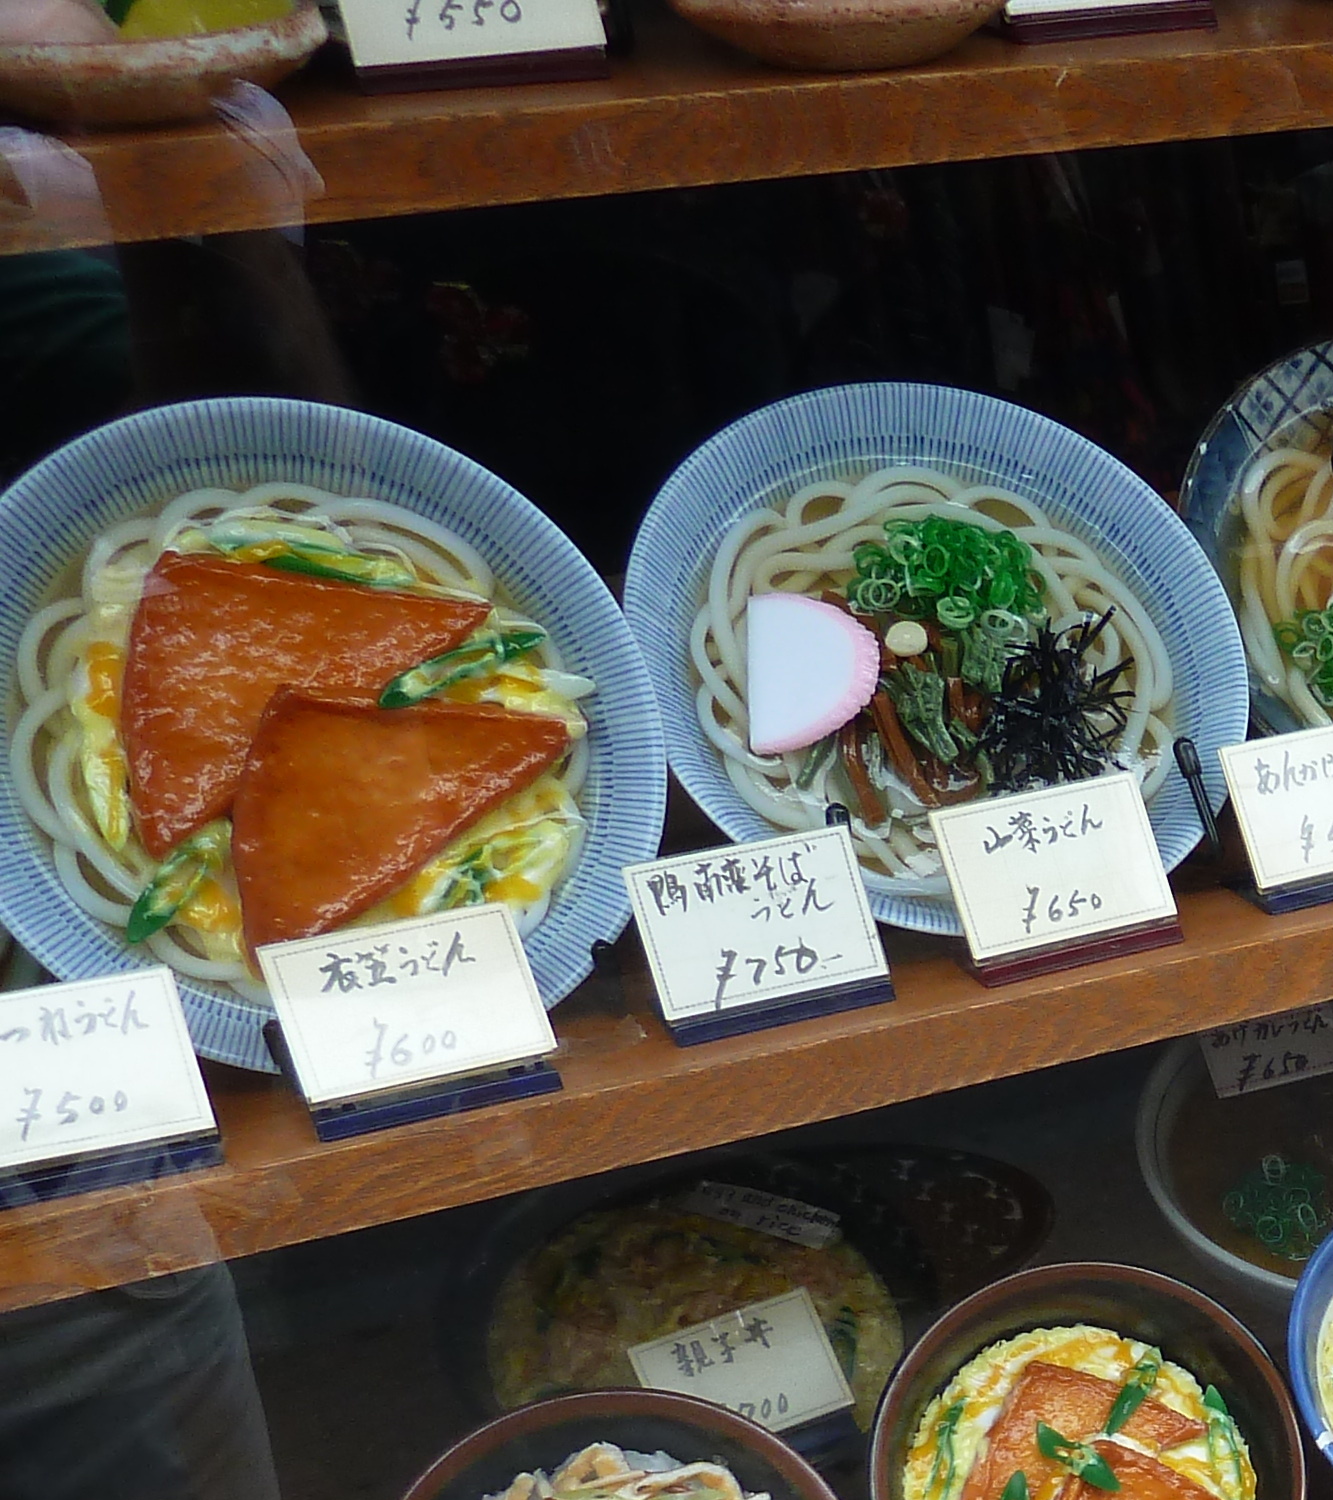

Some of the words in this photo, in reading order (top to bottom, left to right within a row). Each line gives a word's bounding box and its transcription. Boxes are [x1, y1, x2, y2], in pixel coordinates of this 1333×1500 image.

[1023, 886, 1103, 933] ¥650
[365, 1017, 458, 1078] ¥600
[15, 1087, 130, 1142] ¥500
[671, 1317, 774, 1377] 親子丼
